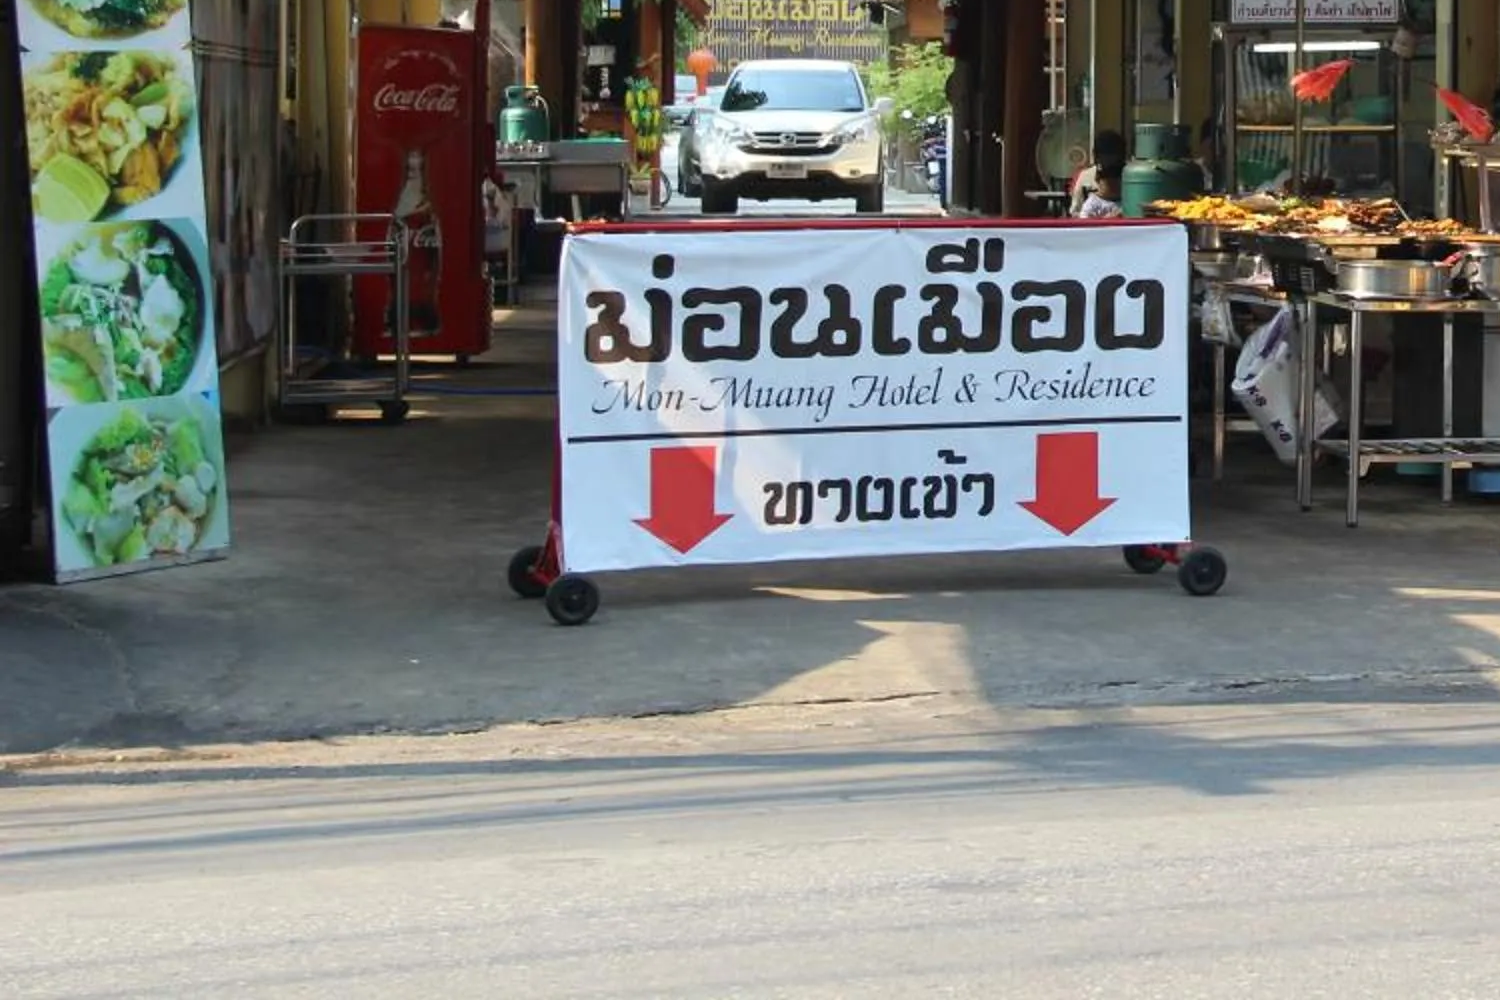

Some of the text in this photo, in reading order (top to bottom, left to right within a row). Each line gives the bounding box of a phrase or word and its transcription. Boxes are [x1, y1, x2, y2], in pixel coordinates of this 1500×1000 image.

[584, 238, 1165, 363] ม่อนเมือง
[592, 362, 1155, 422] Mon-Muang Hotel & Residence
[763, 450, 995, 525] ทางเข้า
